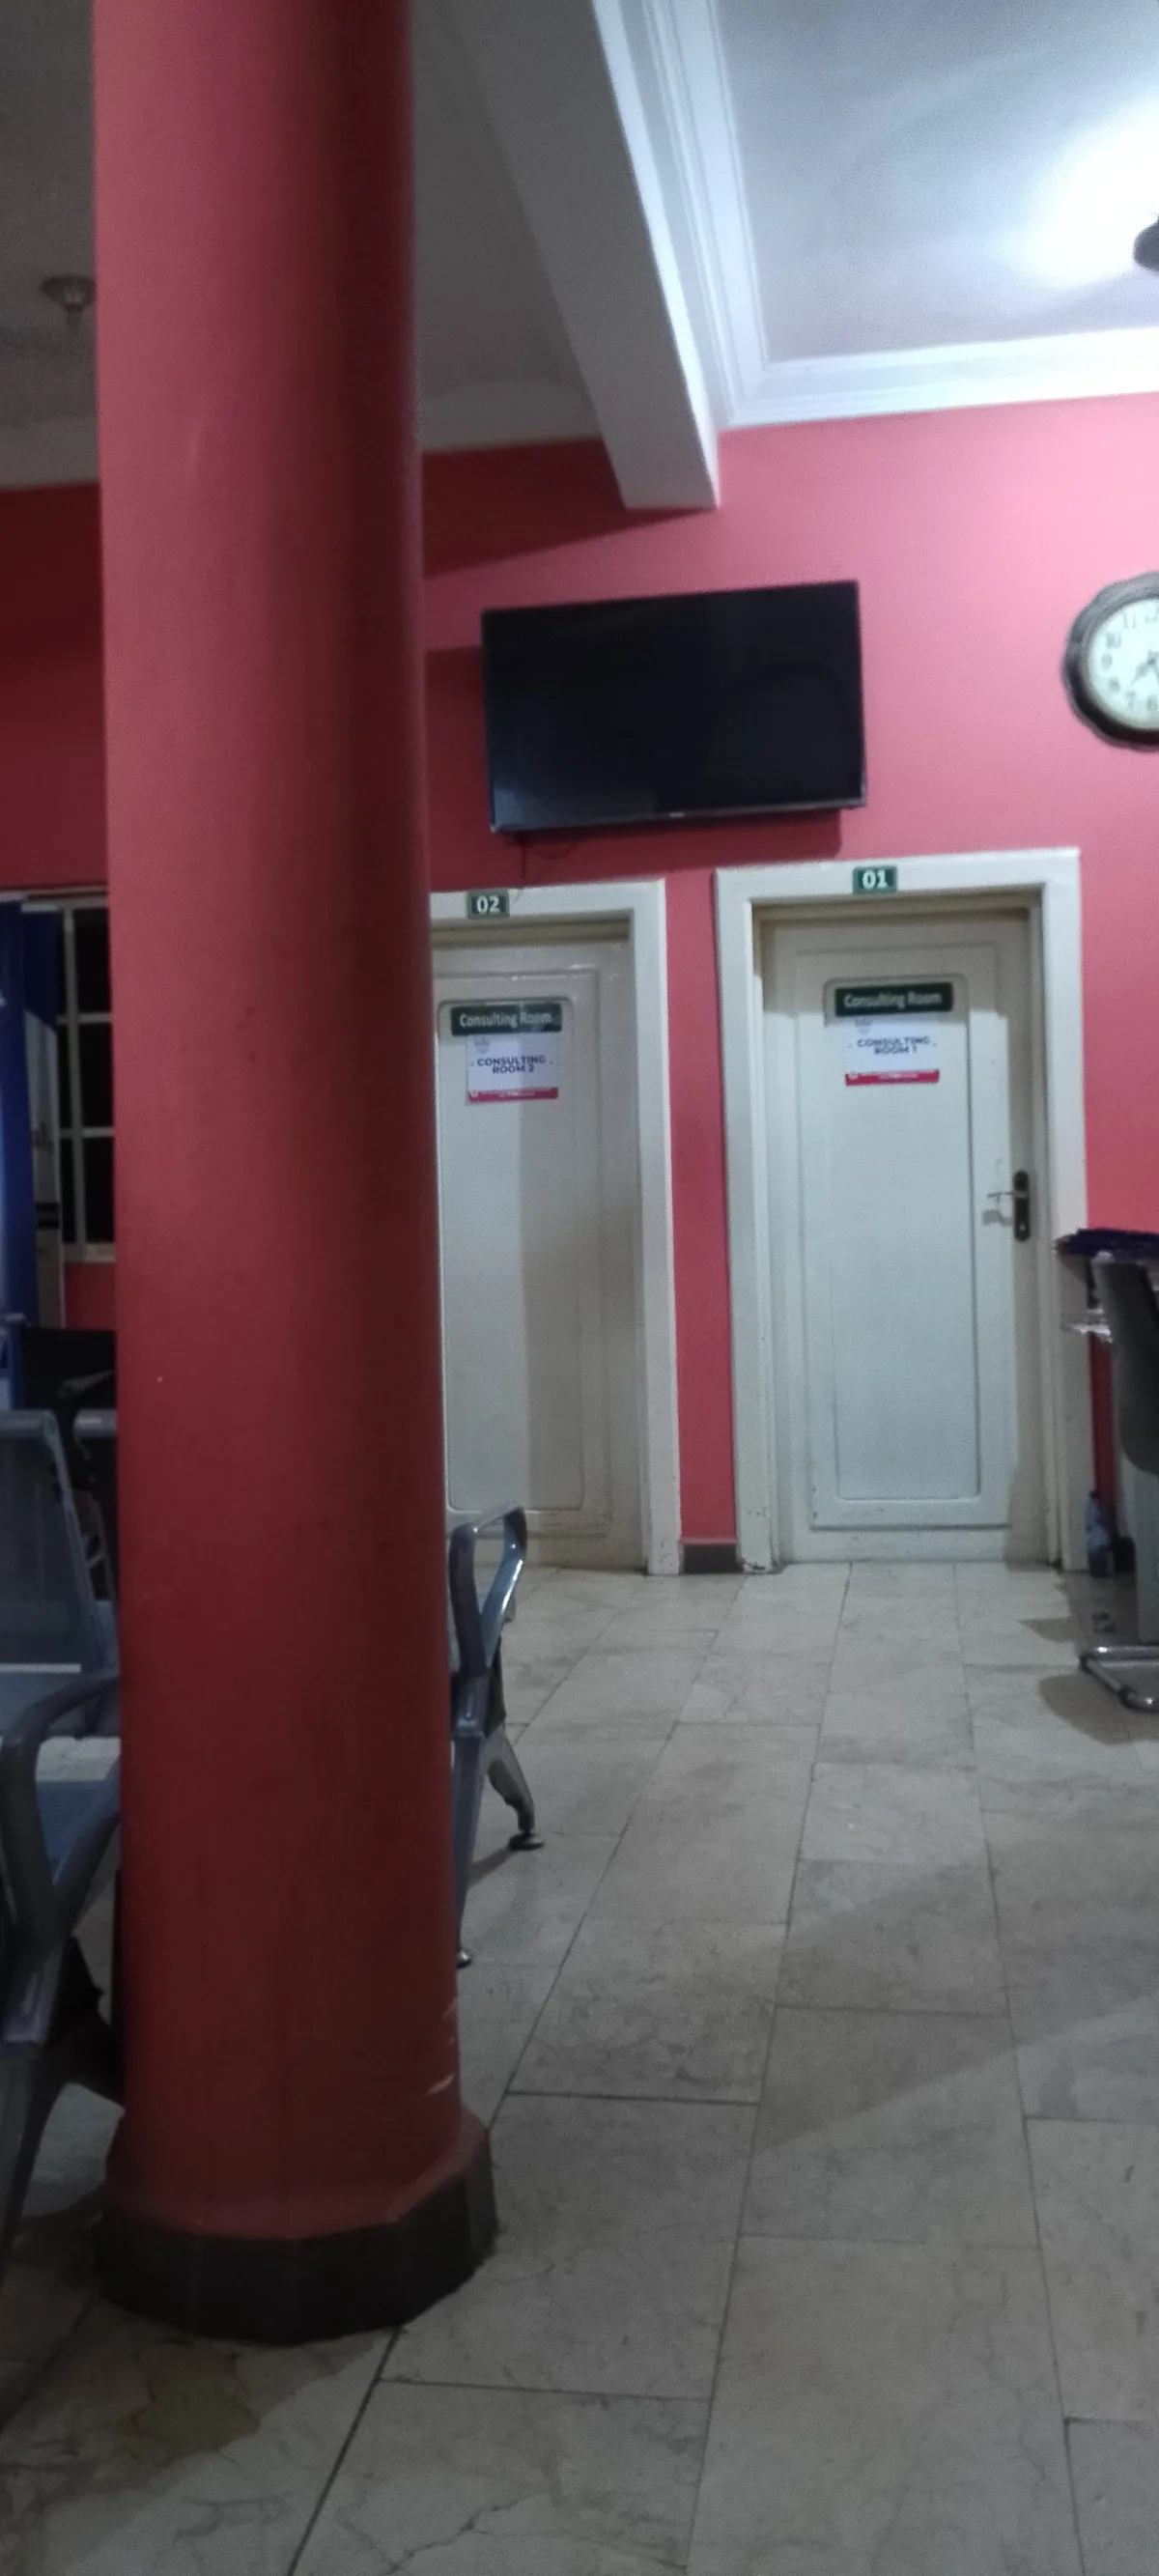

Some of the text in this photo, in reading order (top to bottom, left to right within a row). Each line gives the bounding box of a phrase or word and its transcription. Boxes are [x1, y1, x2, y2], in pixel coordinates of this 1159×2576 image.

[862, 869, 889, 890] 01
[476, 895, 499, 915] 02
[843, 991, 943, 1009] Consulting Room
[460, 1011, 552, 1029] Consulting Room
[857, 1036, 930, 1048] CONSULTING
[874, 1046, 910, 1055] ROOM
[477, 1055, 547, 1066] CONSULTING
[493, 1064, 535, 1074] ROOM 2
